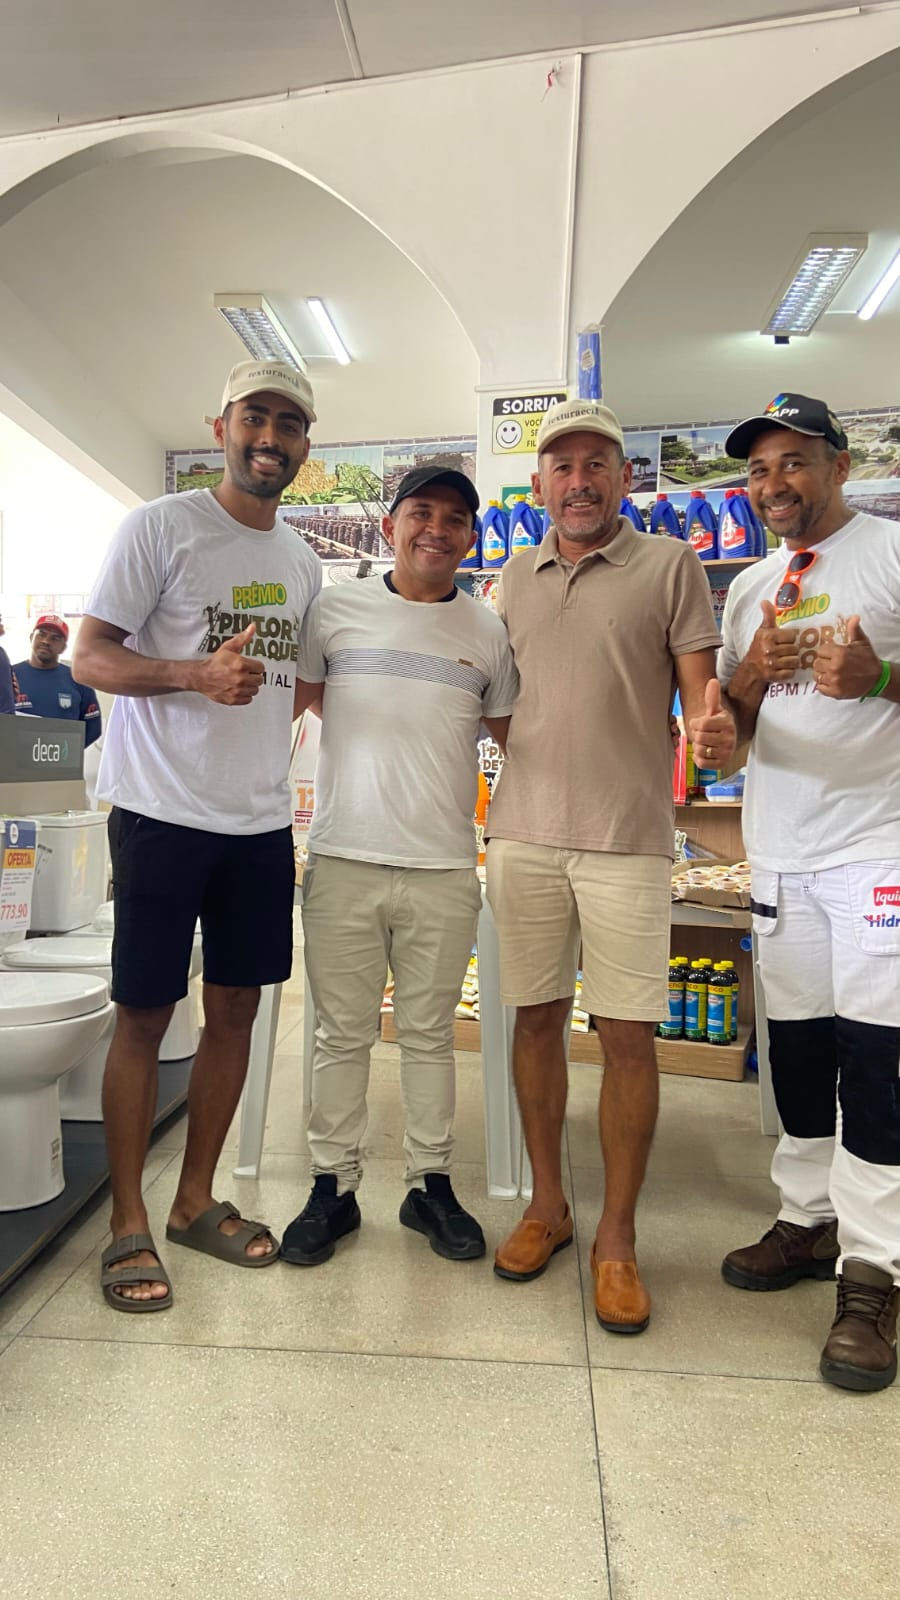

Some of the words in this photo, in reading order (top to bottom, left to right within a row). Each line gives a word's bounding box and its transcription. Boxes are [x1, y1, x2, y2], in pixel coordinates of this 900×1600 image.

[501, 396, 559, 414] SORRIA
[232, 581, 287, 609] PRÊMIO
[32, 737, 60, 762] deca
[7, 852, 32, 866] OFERTA
